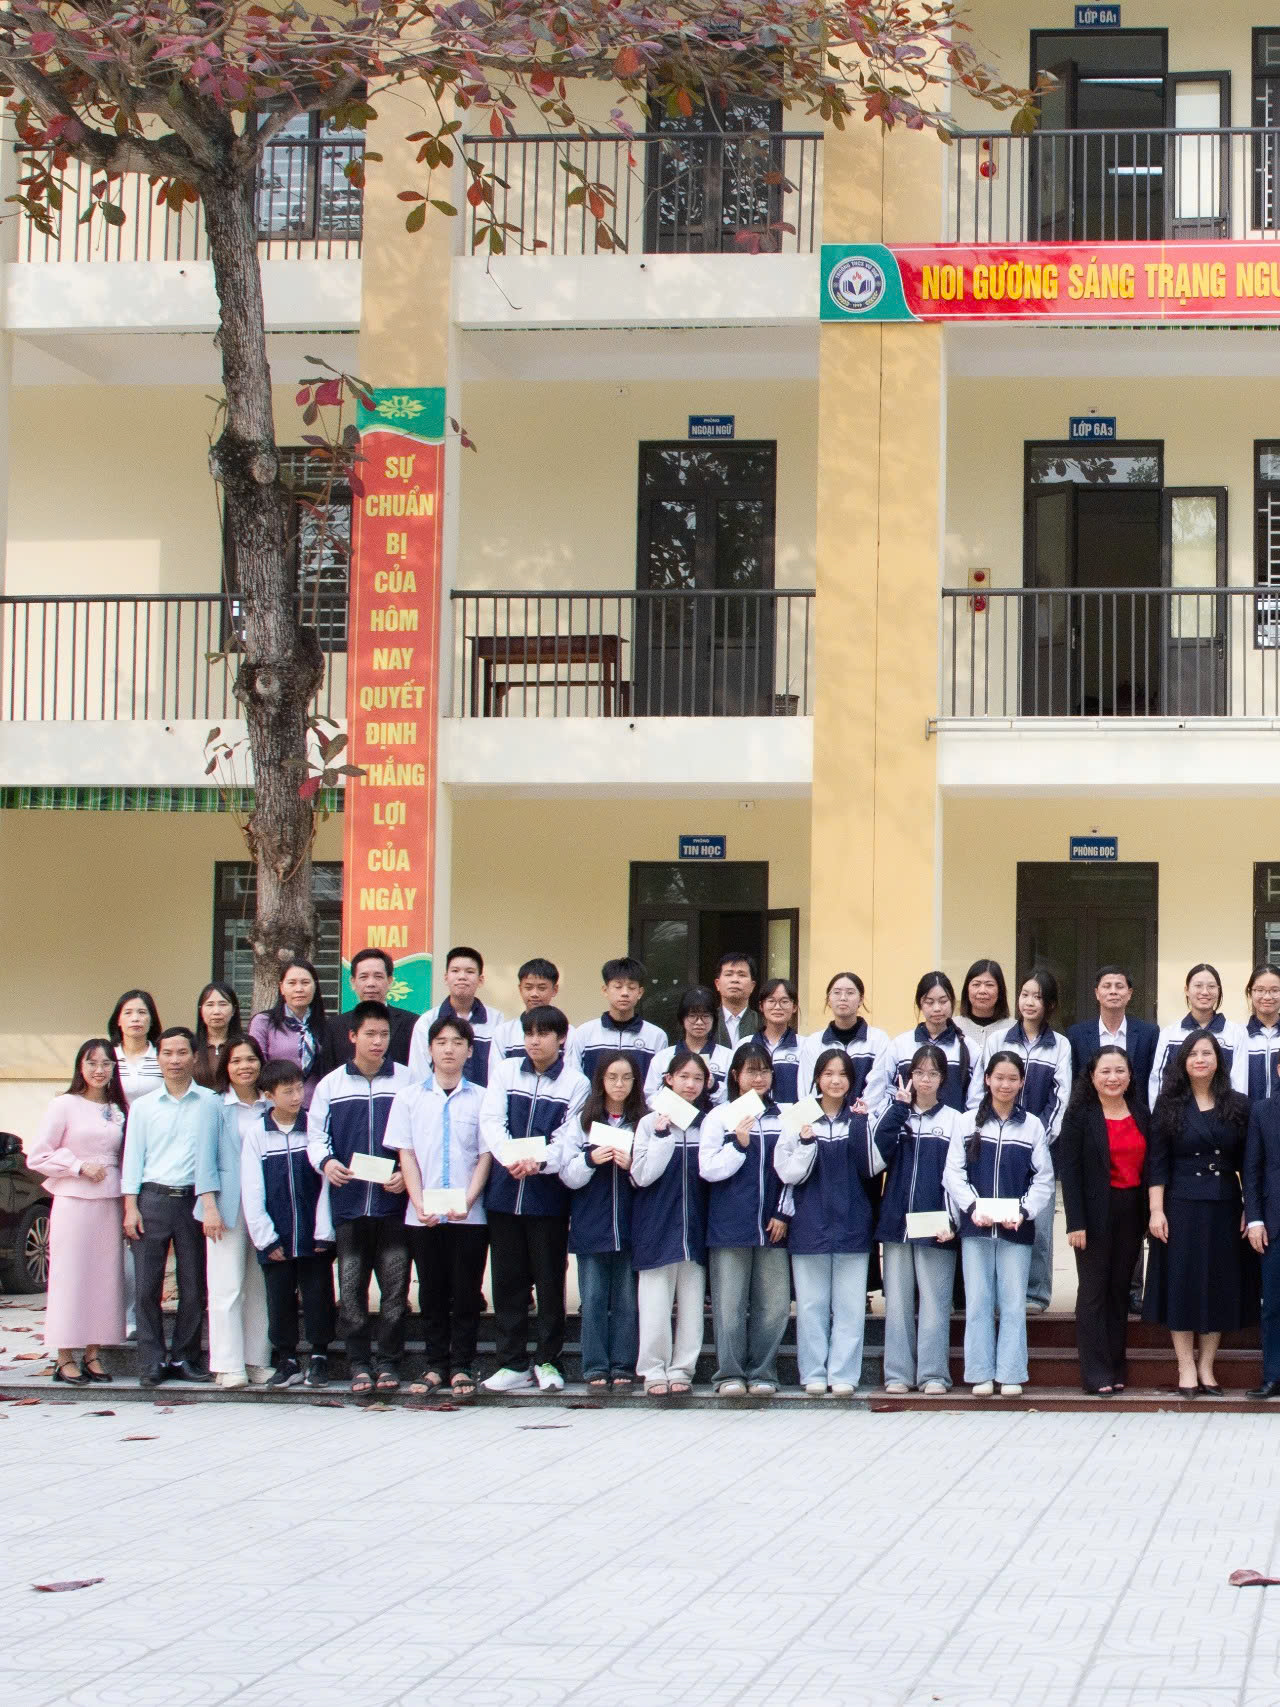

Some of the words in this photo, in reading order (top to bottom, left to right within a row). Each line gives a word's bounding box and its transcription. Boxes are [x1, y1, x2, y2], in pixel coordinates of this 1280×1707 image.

[1078, 8, 1098, 24] LỚP
[922, 263, 964, 300] NOI
[972, 260, 1058, 300] GƯƠNG
[1067, 255, 1135, 300] SÁNG
[1144, 261, 1226, 306] TRẠNG
[691, 424, 715, 437] NGOẠI
[715, 423, 733, 435] NGỮ
[1073, 420, 1093, 437] LỚP
[1093, 422, 1114, 437] 6A3
[384, 454, 416, 483] SỰ
[365, 484, 434, 517] CHUẨN
[386, 532, 408, 560] BỊ
[374, 563, 417, 593] CỦA
[370, 604, 419, 632] HÔM
[372, 647, 414, 671] NAY
[359, 678, 425, 712] QUYẾT
[366, 722, 417, 750] ĐỊNH
[358, 755, 425, 786] THẮNG
[373, 800, 407, 831] LỢI
[367, 841, 411, 872] CỦA
[683, 845, 700, 856] TIN
[700, 845, 722, 858] HỌC
[1072, 844, 1099, 857] PHÒNG
[1099, 846, 1116, 859] ĐỌC
[359, 882, 417, 911] NGÀY
[367, 925, 409, 948] MAI
